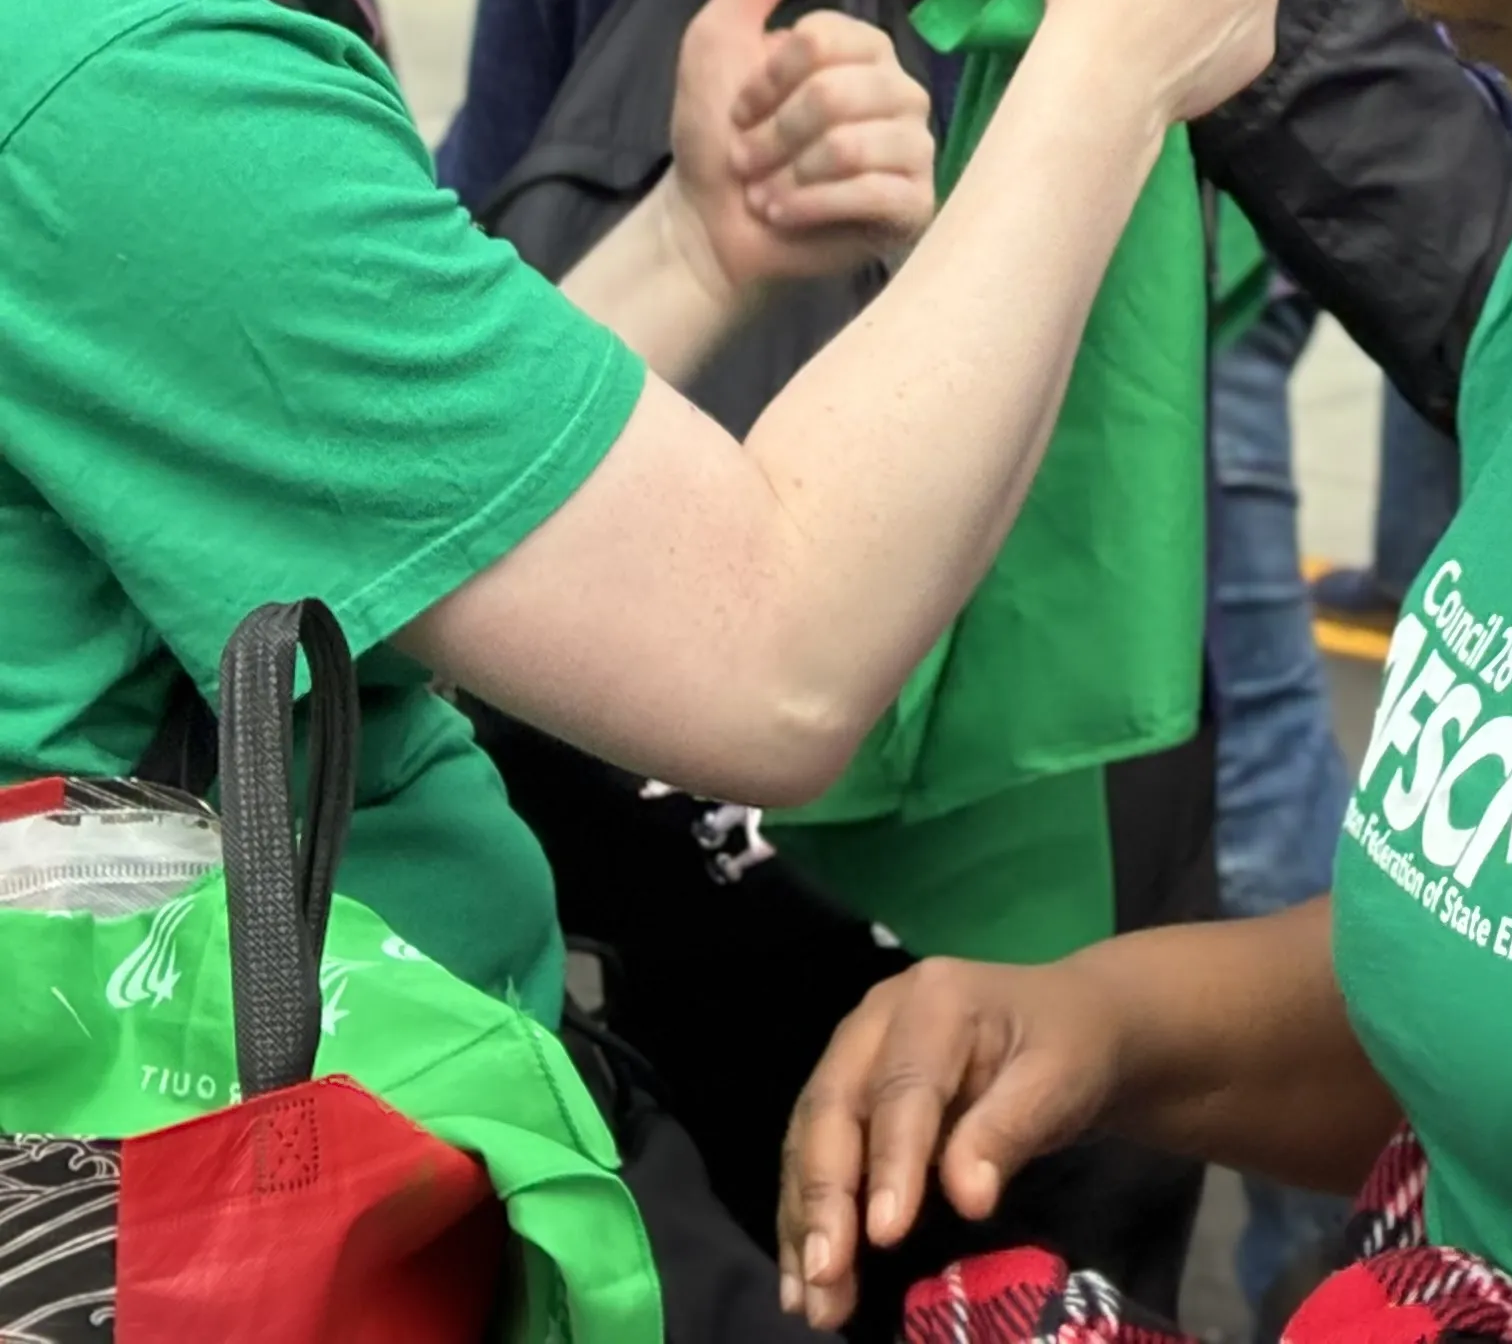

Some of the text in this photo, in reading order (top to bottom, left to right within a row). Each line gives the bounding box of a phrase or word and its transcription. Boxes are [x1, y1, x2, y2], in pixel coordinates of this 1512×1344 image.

[1423, 557, 1505, 671] Council
[1359, 811, 1427, 902] Federation
[1421, 875, 1450, 915] of
[1439, 885, 1493, 949] State
